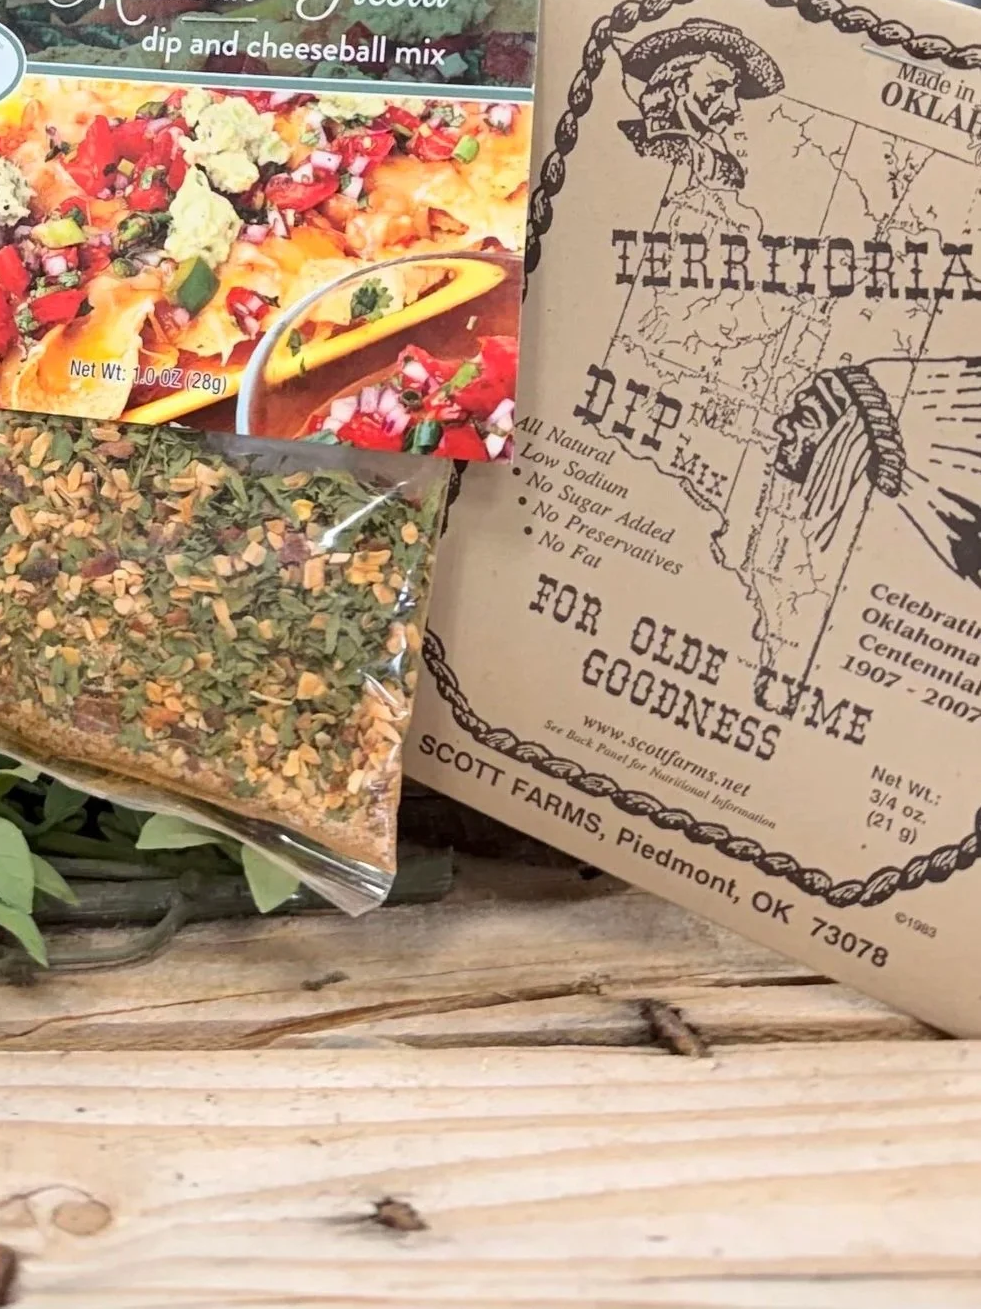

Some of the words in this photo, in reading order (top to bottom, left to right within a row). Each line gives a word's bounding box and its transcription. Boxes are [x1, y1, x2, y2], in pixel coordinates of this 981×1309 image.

[141, 27, 182, 59] dip
[189, 31, 238, 58] and
[246, 33, 386, 65] cheeseball
[394, 38, 446, 67] mix
[896, 63, 952, 95] Made
[954, 79, 976, 104] in
[70, 359, 96, 379] Net
[101, 362, 127, 382] Wt:
[132, 365, 156, 385] 1.0
[160, 368, 183, 388] OZ
[185, 371, 227, 395] (28g)
[514, 415, 543, 436] All
[545, 426, 617, 467] Natural
[573, 364, 683, 451] DIP
[670, 445, 728, 498] MIX
[519, 441, 560, 469] Low
[563, 460, 630, 499] Sodium
[525, 470, 555, 495] No
[557, 484, 613, 518] Sugar
[614, 510, 677, 545] Added
[531, 500, 560, 524] No
[564, 513, 685, 576] Preservatives
[537, 530, 566, 555] No
[569, 542, 604, 571] Fat
[529, 572, 603, 638] FOR
[630, 615, 730, 688] OLDE
[861, 607, 981, 668] Oklahoma
[839, 653, 903, 689] 1907
[920, 687, 981, 724] 2007
[858, 634, 981, 697] Centennial
[581, 648, 784, 764] GOODNESS
[544, 719, 563, 736] See
[566, 728, 594, 749] Back
[595, 738, 629, 766] Panel
[628, 755, 648, 773] for
[649, 766, 712, 801] Nutritional
[711, 793, 778, 830] Information
[583, 715, 753, 798] www.scottfarms.net
[871, 764, 903, 789] Net
[909, 779, 943, 807] Wt.:
[866, 809, 894, 833] (21
[898, 826, 918, 846] g)
[869, 788, 898, 810] 3/4
[902, 804, 927, 825] oz.
[418, 732, 506, 788] SCOTT
[509, 775, 607, 843] FARMS,
[616, 826, 742, 906] Piedmont,
[751, 889, 796, 925] OK
[809, 917, 890, 969] 73078
